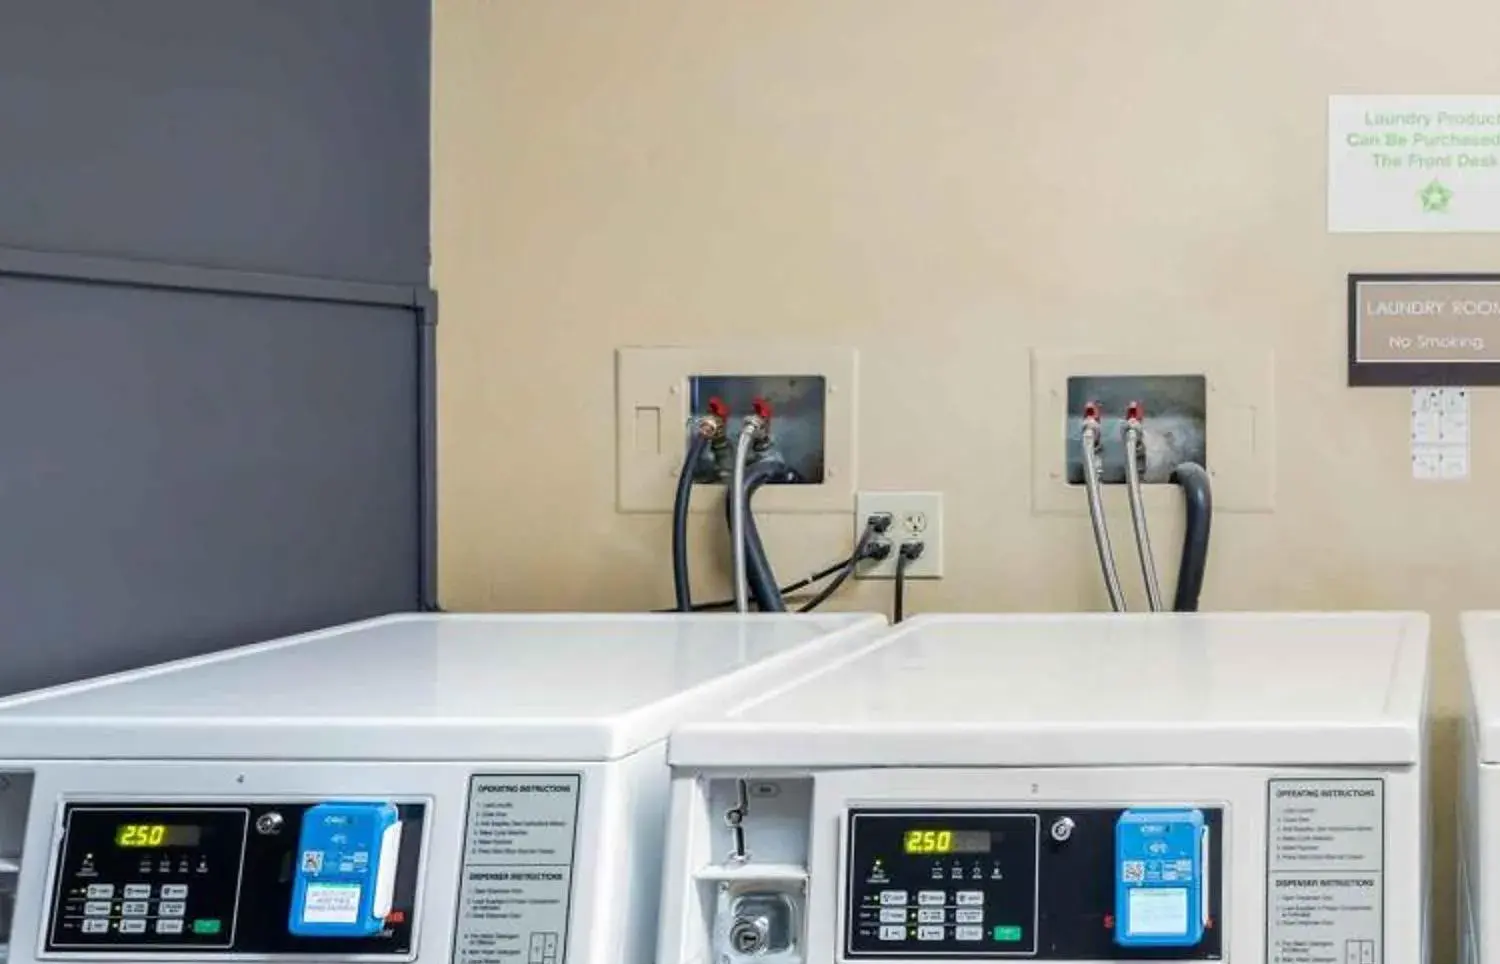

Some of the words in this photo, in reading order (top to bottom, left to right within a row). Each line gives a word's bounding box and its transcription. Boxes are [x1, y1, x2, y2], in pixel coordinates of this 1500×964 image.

[1365, 111, 1430, 127] Laundry
[1346, 132, 1379, 147] Can
[1384, 132, 1407, 147] Be
[1413, 132, 1500, 147] Purchased
[1373, 153, 1402, 168] The
[1408, 153, 1451, 168] Front
[1457, 153, 1498, 168] Desk
[1366, 300, 1443, 316] LAUNDRY
[1389, 335, 1412, 349] No
[1416, 335, 1485, 351] Smoking
